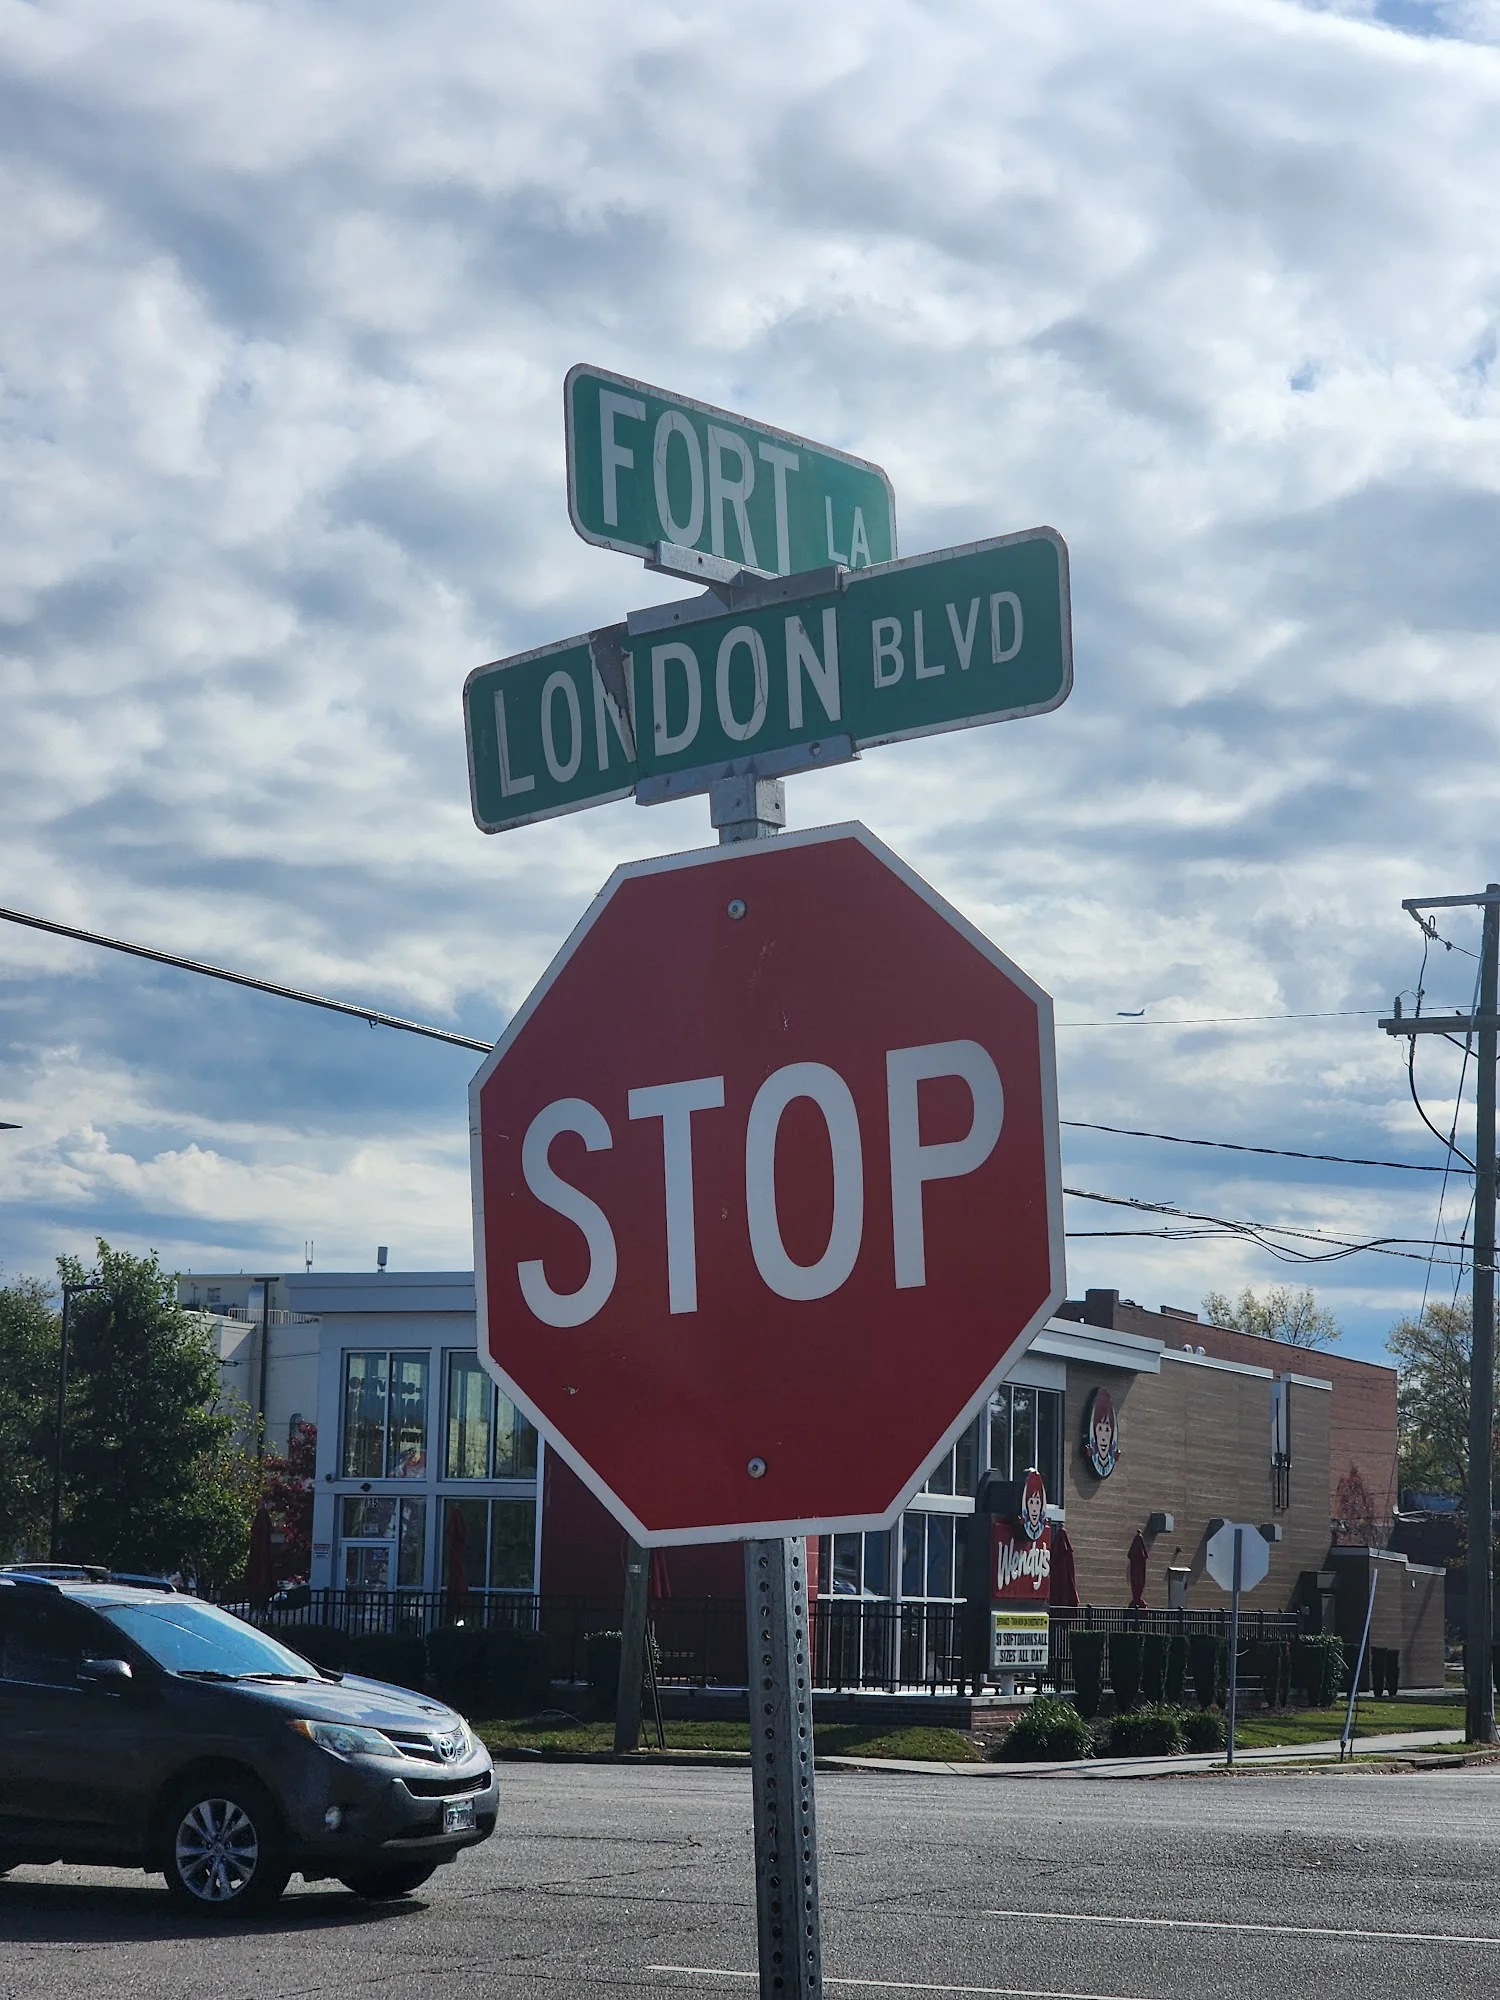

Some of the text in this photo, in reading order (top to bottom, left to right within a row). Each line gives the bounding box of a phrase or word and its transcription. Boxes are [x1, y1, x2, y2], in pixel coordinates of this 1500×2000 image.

[599, 386, 872, 577] FORT LA
[494, 591, 1024, 798] LONDON BLVD
[517, 1039, 1005, 1328] STOP
[997, 1537, 1050, 1590] Wendy's
[1000, 1649, 1043, 1662] SIZES ALL DAY
